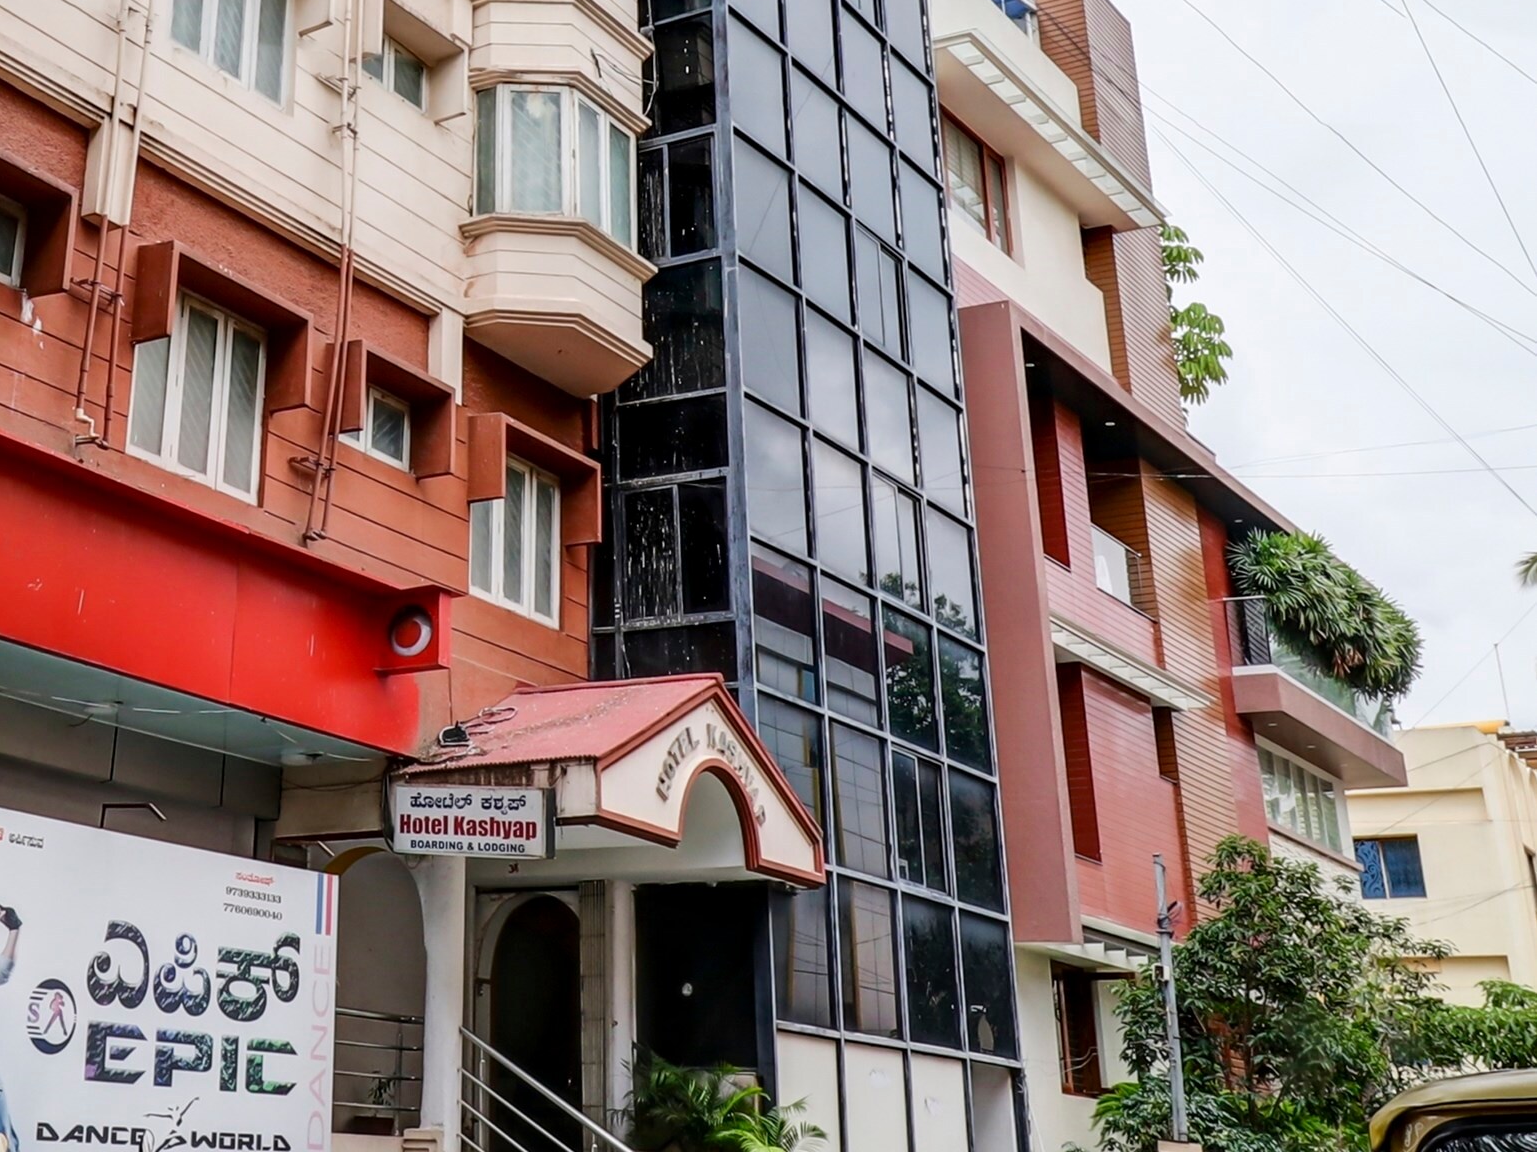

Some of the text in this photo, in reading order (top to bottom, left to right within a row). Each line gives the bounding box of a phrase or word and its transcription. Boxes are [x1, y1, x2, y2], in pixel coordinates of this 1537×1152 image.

[656, 726, 700, 803] HOTEL
[400, 814, 537, 841] Hotel Kashyap
[410, 792, 527, 815] ಹೋಟೆಲ್ ಕಶ್ಯಪ್
[410, 839, 525, 854] BOARDING & LODGING
[87, 920, 301, 1022] ಎಪಿಕ್
[84, 1020, 299, 1097] EPIC
[306, 943, 333, 1151] DANCE
[36, 1122, 292, 1152] DANCE WORLD
